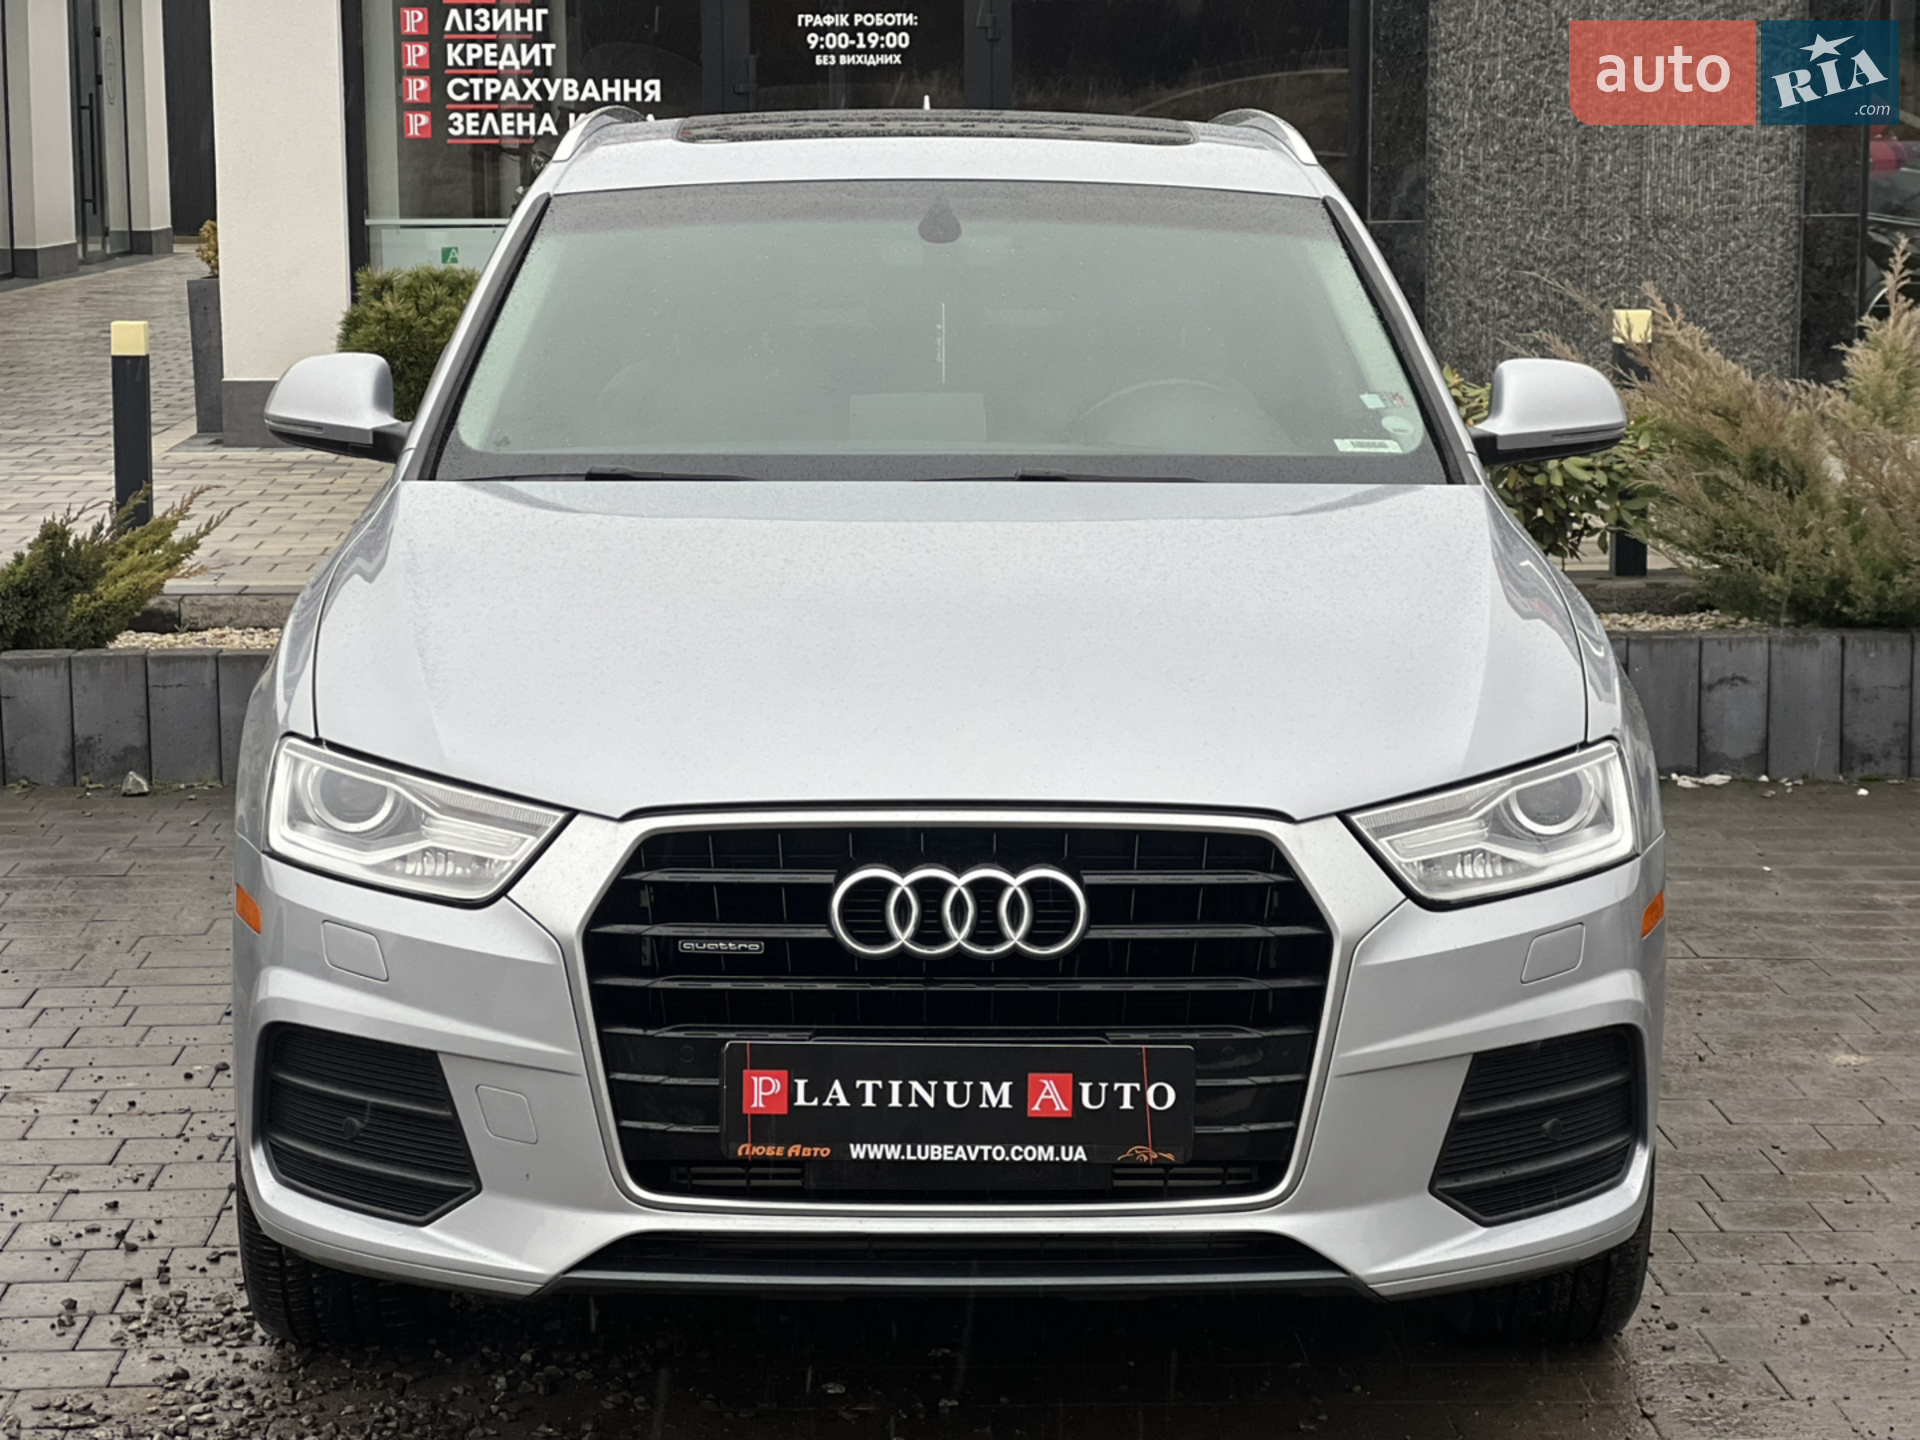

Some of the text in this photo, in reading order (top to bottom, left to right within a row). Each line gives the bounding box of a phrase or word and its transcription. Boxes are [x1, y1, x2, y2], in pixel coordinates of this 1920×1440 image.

[444, 8, 548, 32] ЛІЗИНГ
[797, 12, 918, 27] ГРАФІК РОБОТИ:
[806, 31, 910, 49] 9:00-19:00
[446, 43, 556, 70] КРЕДИТ
[815, 54, 902, 66] БЕЗ ВИХІДНИХ
[446, 78, 661, 102] СТРАХУВАННЯ
[447, 112, 558, 136] ЗЕЛЕНА
[682, 942, 760, 951] quattro
[750, 1076, 1177, 1111] PLATINUM AUTO
[849, 1143, 1088, 1162] WWW.LUBEAVTO.COM.UA
